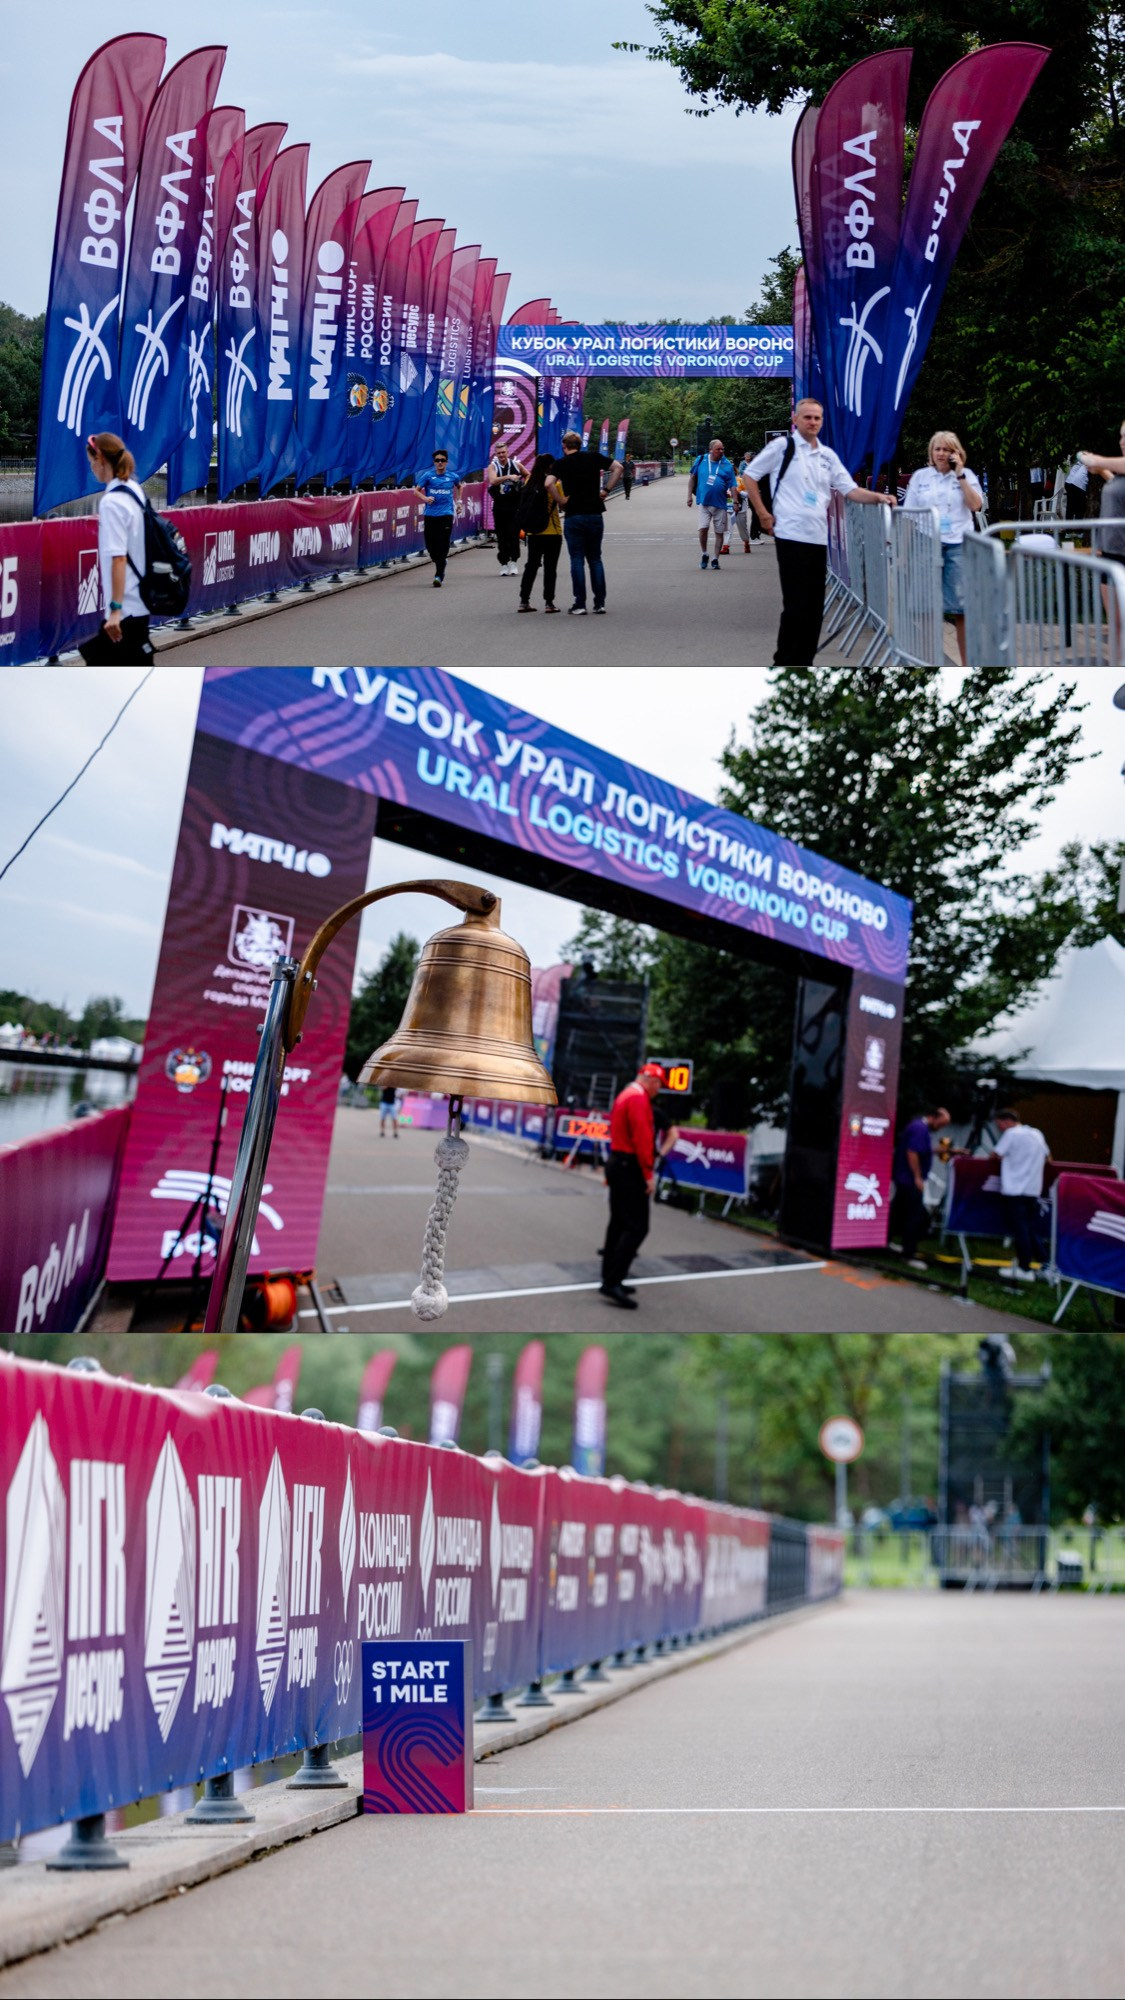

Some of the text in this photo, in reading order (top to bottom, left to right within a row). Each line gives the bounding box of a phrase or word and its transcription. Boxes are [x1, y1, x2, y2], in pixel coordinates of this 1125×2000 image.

[80, 115, 124, 270] ВФЛА
[150, 128, 196, 276] ВФЛА
[843, 130, 877, 269] ВФЛА
[229, 188, 256, 309] ВФЛА
[360, 284, 375, 359] РОССИИ
[380, 295, 393, 366] РОССИИ
[447, 317, 461, 374] LOGISTICS
[511, 337, 566, 351] КУБОК
[571, 337, 614, 351] УРАЛ
[619, 337, 720, 351] ЛОГИСТИКИ
[546, 355, 784, 367] URAL LOGISTICS VORONOVO CUP
[216, 564, 235, 583] LOGISTICS
[218, 529, 236, 562] URAL
[417, 747, 849, 943] URAL LOGISTICS VORONOVO CUP
[494, 729, 595, 800] УРАЛ
[601, 786, 773, 881] ЛОГИСТИКИ
[777, 862, 888, 932] ВОРОНОВО
[68, 1458, 126, 1640] НГК
[197, 1474, 241, 1628] НГК
[289, 1483, 325, 1617] НГК
[359, 1512, 411, 1574] КОМАНДА
[437, 1516, 482, 1572] КОМАНДА
[357, 1581, 402, 1639] РОССИИ
[434, 1578, 472, 1628] РОССИИ
[64, 1648, 125, 1741] ресурс
[193, 1636, 237, 1714] ресурс
[286, 1626, 318, 1692] ресурс
[371, 1660, 450, 1679] START
[372, 1684, 448, 1703] 1 MILE
